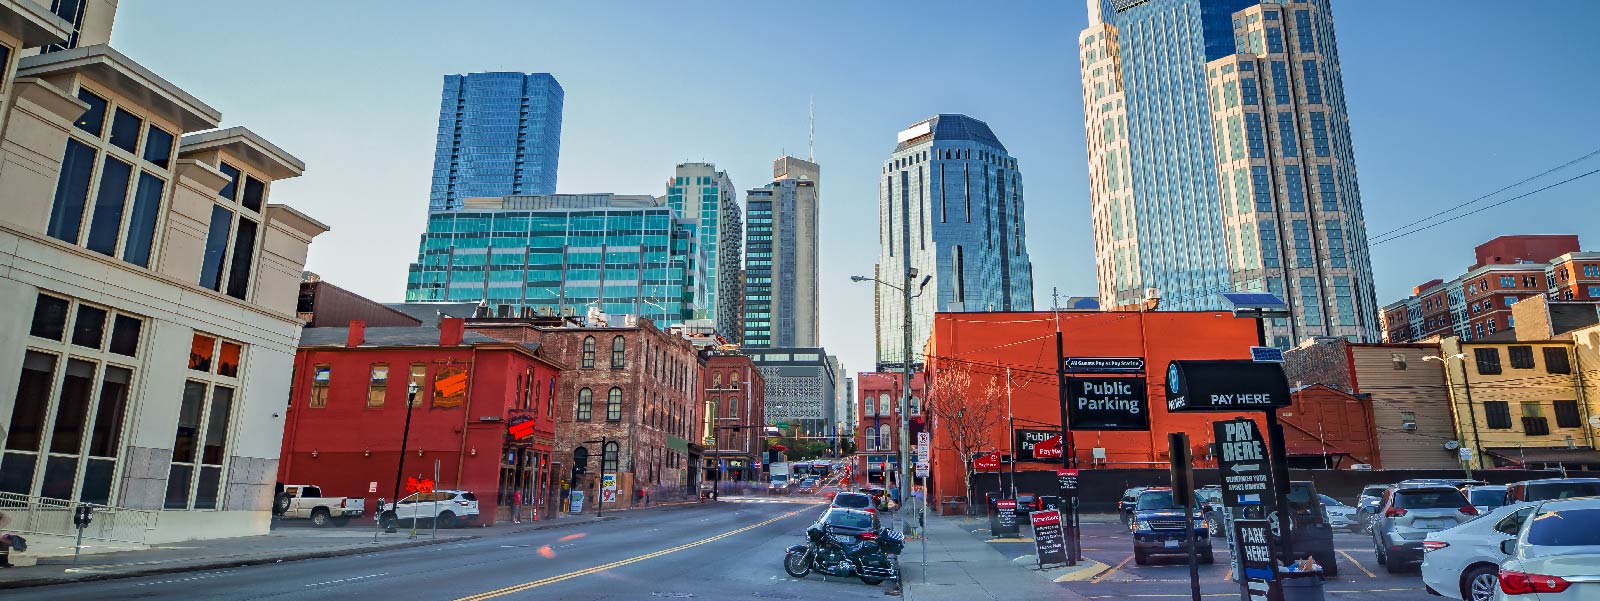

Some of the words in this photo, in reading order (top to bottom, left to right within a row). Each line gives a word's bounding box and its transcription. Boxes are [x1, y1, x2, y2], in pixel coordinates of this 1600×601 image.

[1083, 381, 1132, 395] Public
[1078, 396, 1140, 414] Parking
[1211, 394, 1234, 405] PAY
[1236, 393, 1271, 404] HERE
[1224, 421, 1253, 442] PAY
[1222, 440, 1264, 462] HERE
[1241, 527, 1266, 544] PARK
